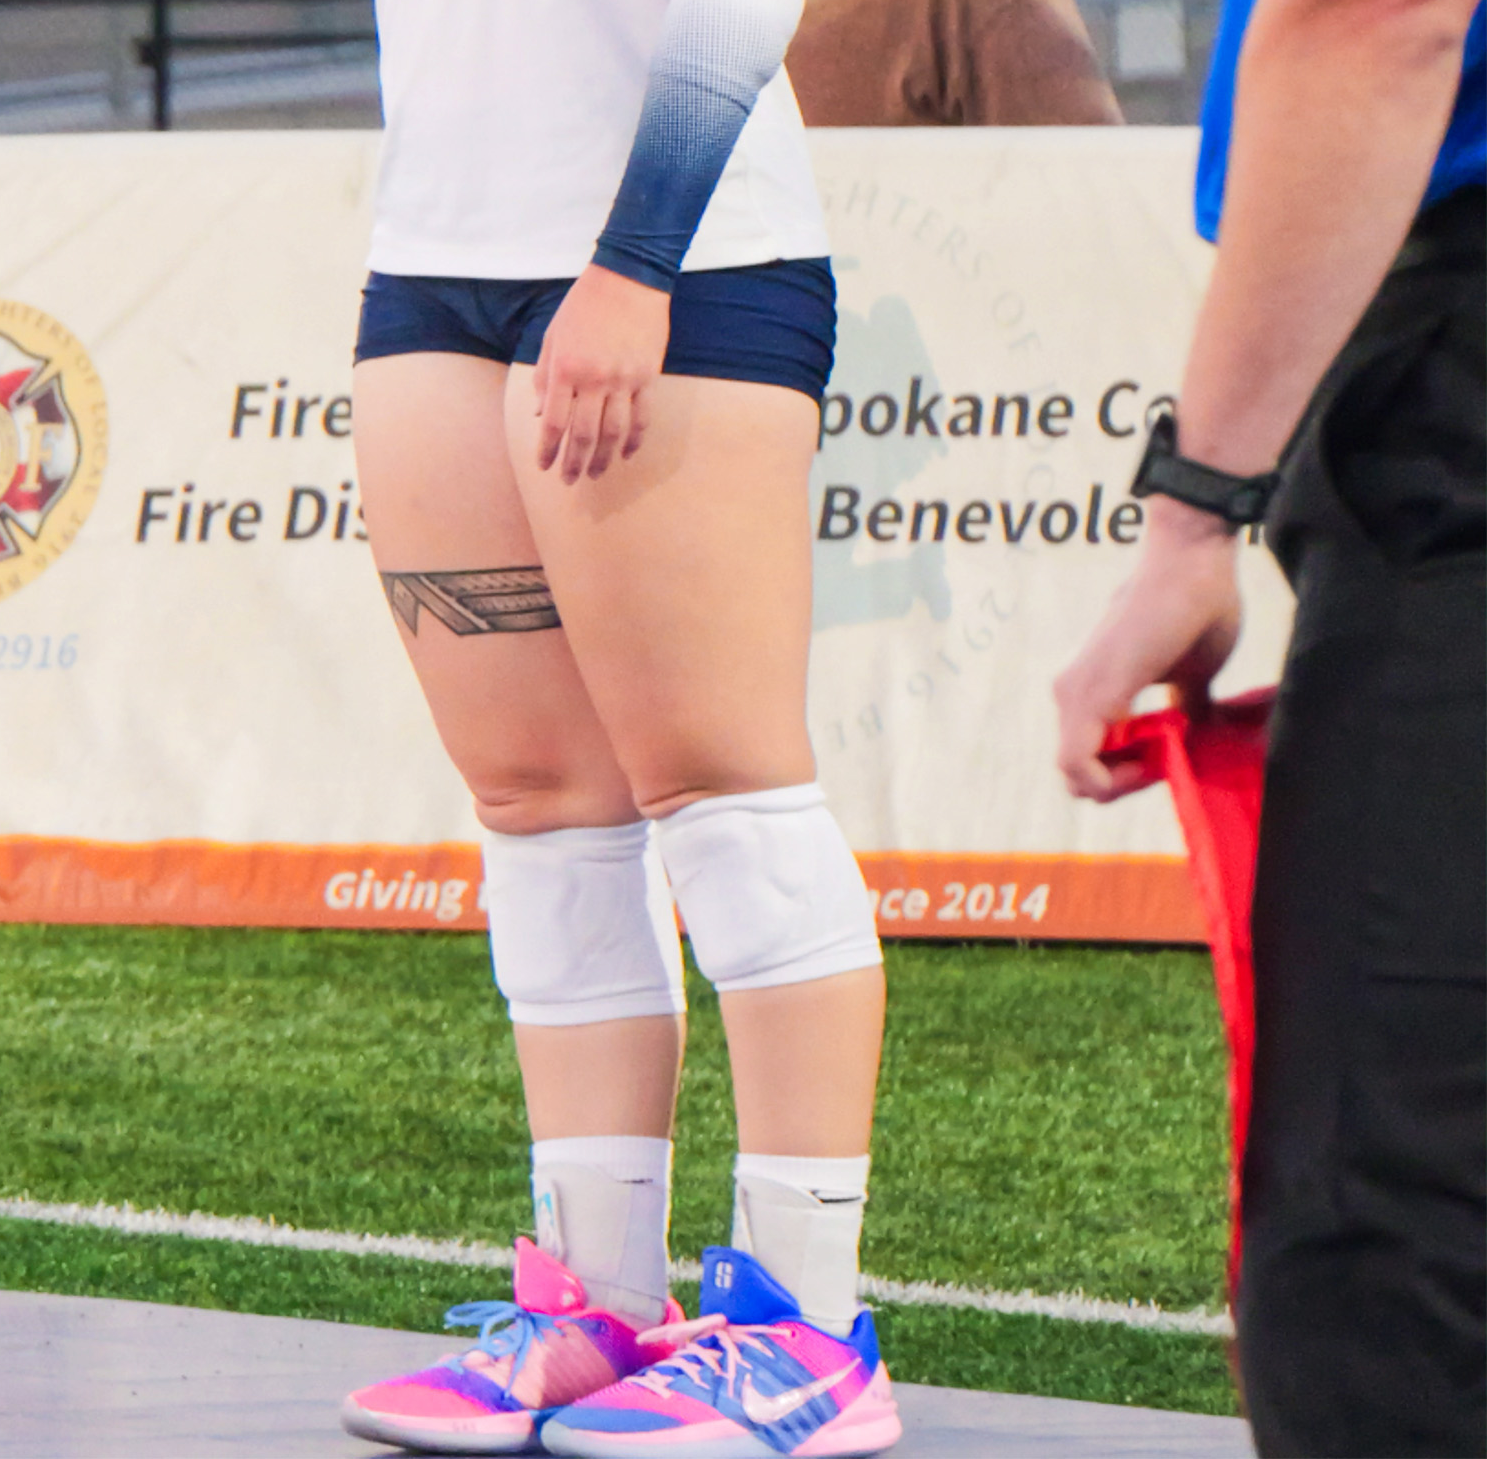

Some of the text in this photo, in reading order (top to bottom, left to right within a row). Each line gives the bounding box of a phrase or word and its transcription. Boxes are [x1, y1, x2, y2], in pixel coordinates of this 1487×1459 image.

[229, 376, 353, 439] Fire
[815, 375, 1076, 453] pokane
[134, 482, 264, 544] Fire
[816, 483, 1145, 545] Benevole
[324, 868, 469, 923] Giving
[936, 881, 1051, 923] 2014
